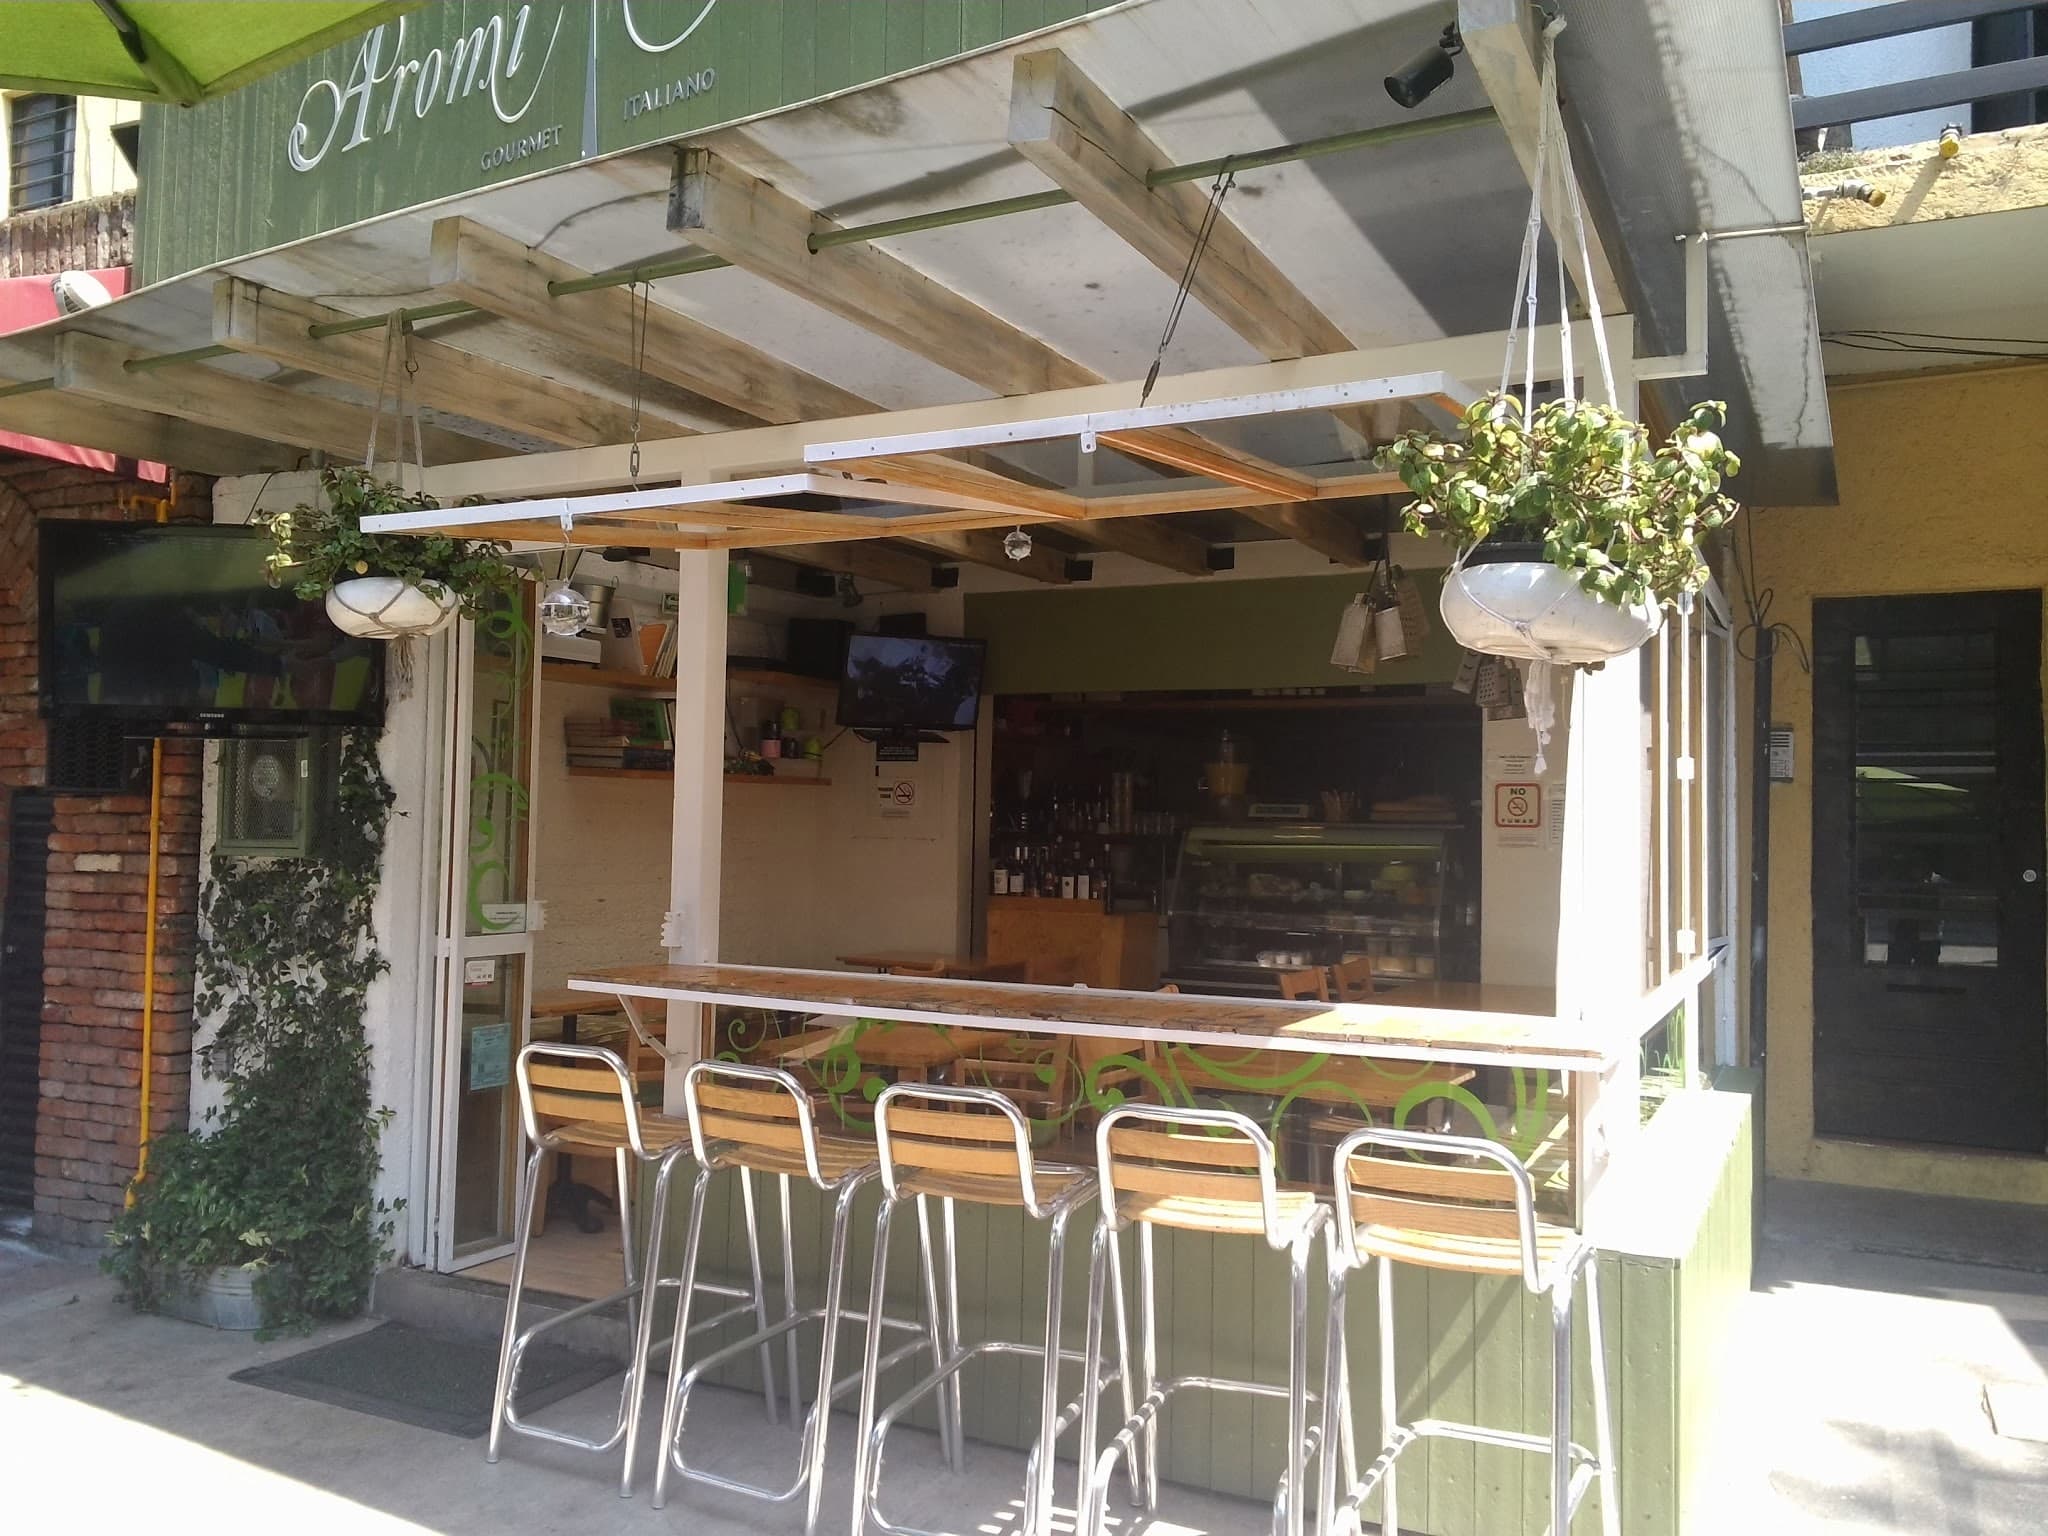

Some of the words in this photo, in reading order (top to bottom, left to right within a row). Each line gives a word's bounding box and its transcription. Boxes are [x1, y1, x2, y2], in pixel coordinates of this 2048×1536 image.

[622, 67, 716, 121] ITALIANO
[480, 124, 564, 171] GOURMET
[1510, 787, 1526, 796] NO
